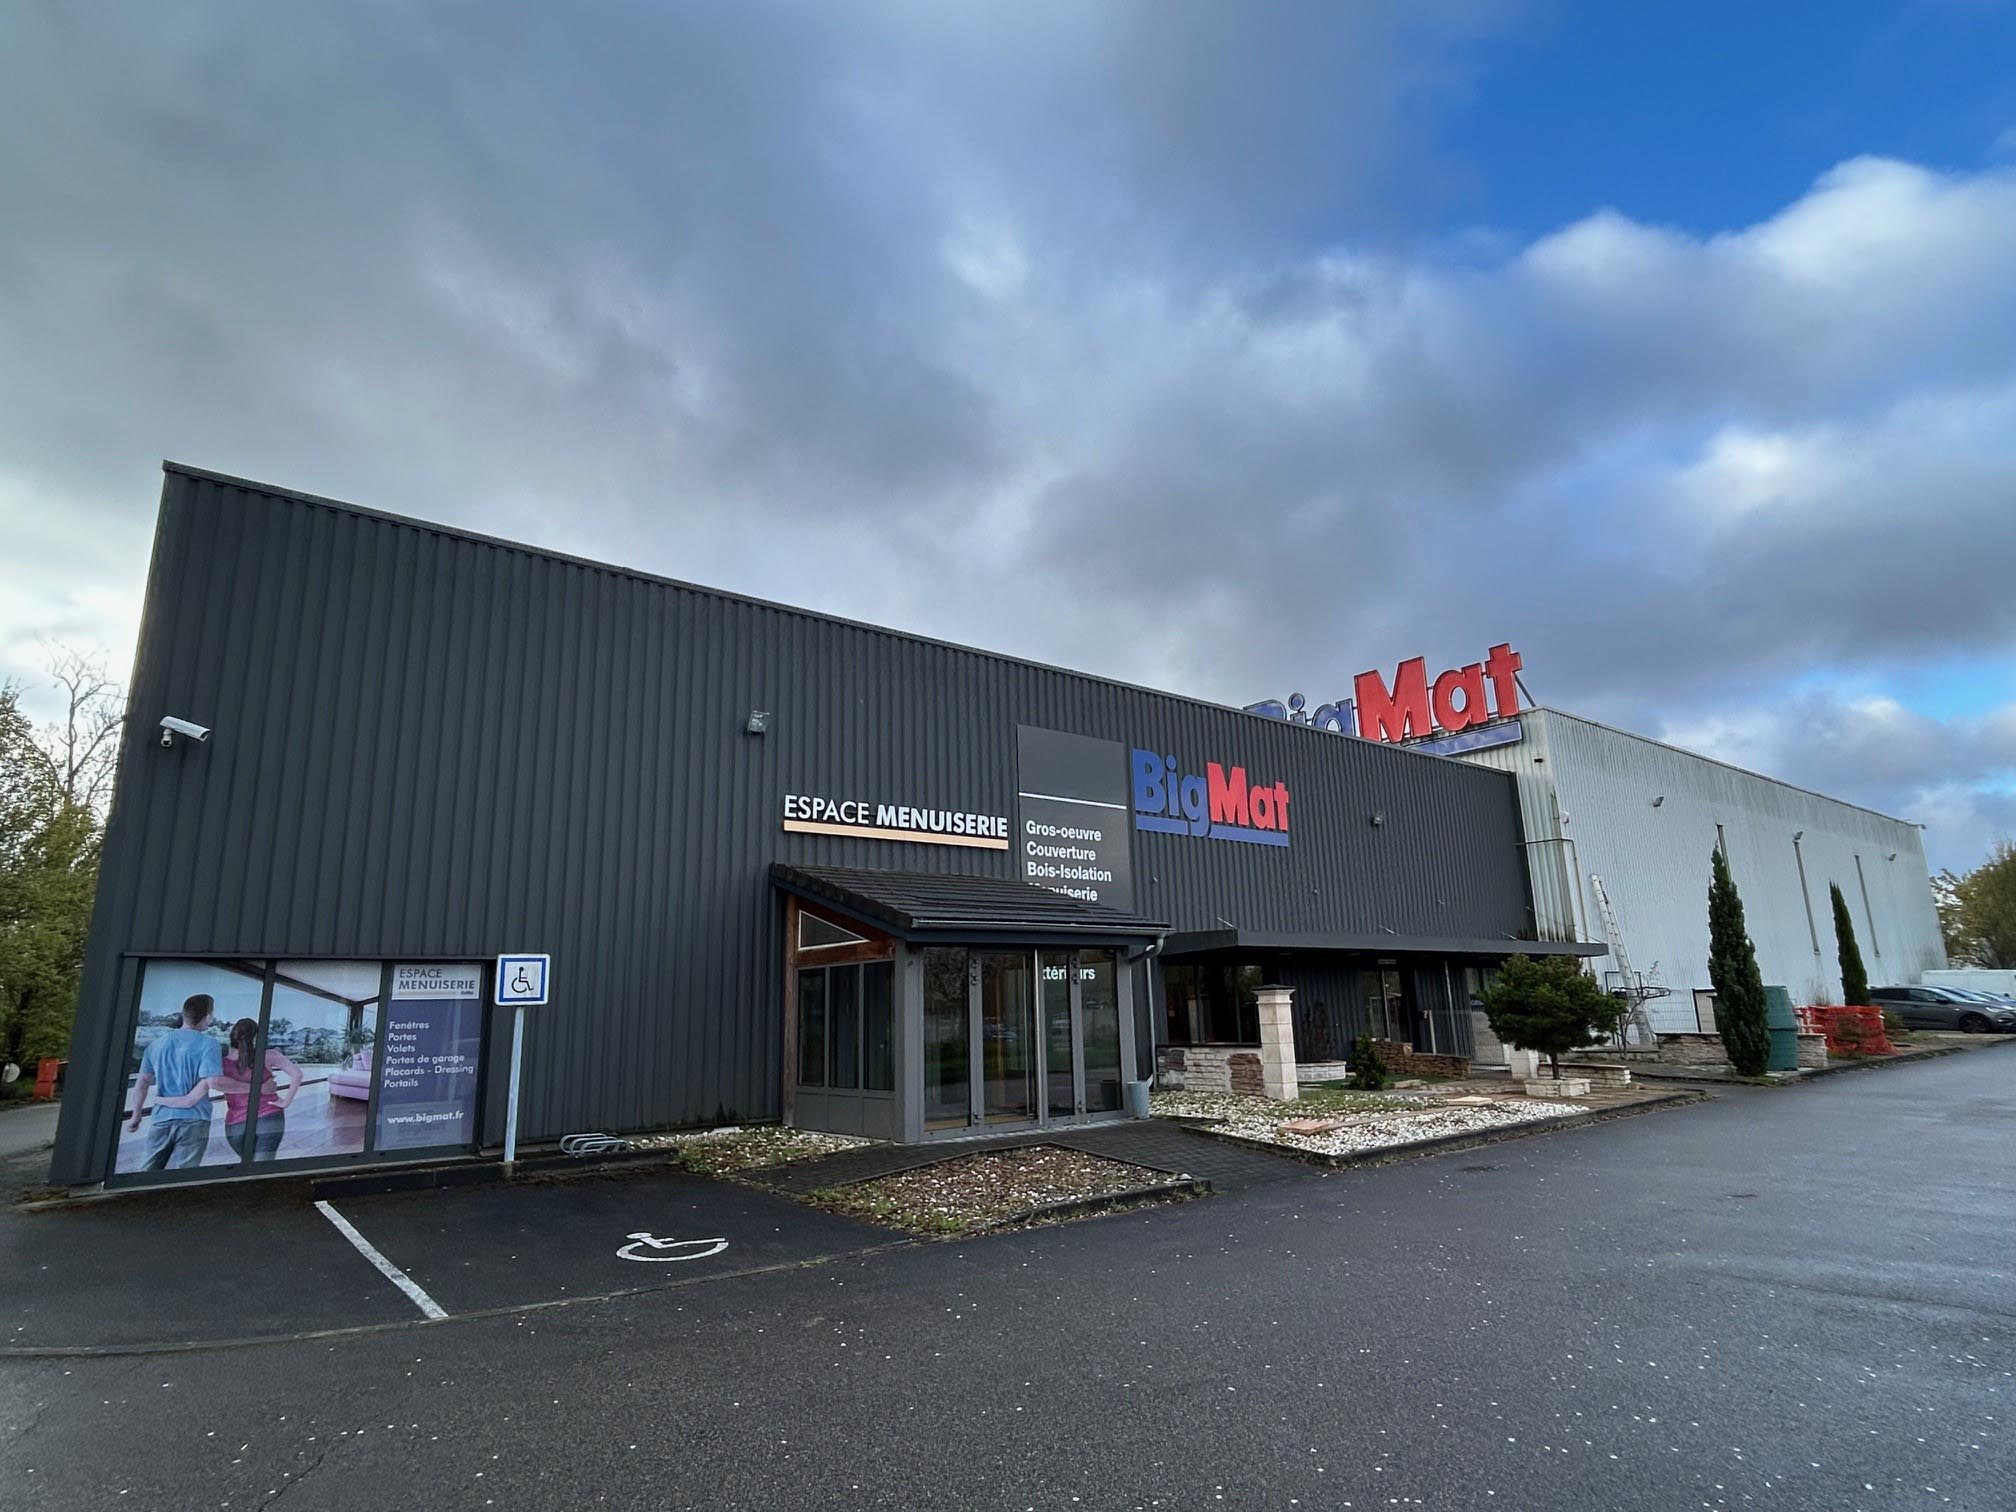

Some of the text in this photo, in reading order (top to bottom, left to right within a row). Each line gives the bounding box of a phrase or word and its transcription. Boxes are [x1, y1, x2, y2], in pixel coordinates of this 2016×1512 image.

[1132, 747, 1290, 837] BigMat
[784, 794, 1008, 838] ESPACE MENUISERIE
[1026, 820, 1102, 841] Gros-oeuvre
[1026, 841, 1096, 860] Couverture
[1027, 861, 1112, 881] Bois-Isolation
[400, 968, 442, 979] ESPACE
[398, 980, 475, 990] MENUISERIE
[388, 1032, 417, 1042] Portes
[387, 1044, 416, 1053] Volets
[385, 1054, 465, 1065] Portes de garage
[384, 1067, 425, 1077] Placards
[434, 1064, 474, 1074] Dressing
[384, 1078, 419, 1088] Portails
[387, 1110, 464, 1124] www.bigmat.fr
